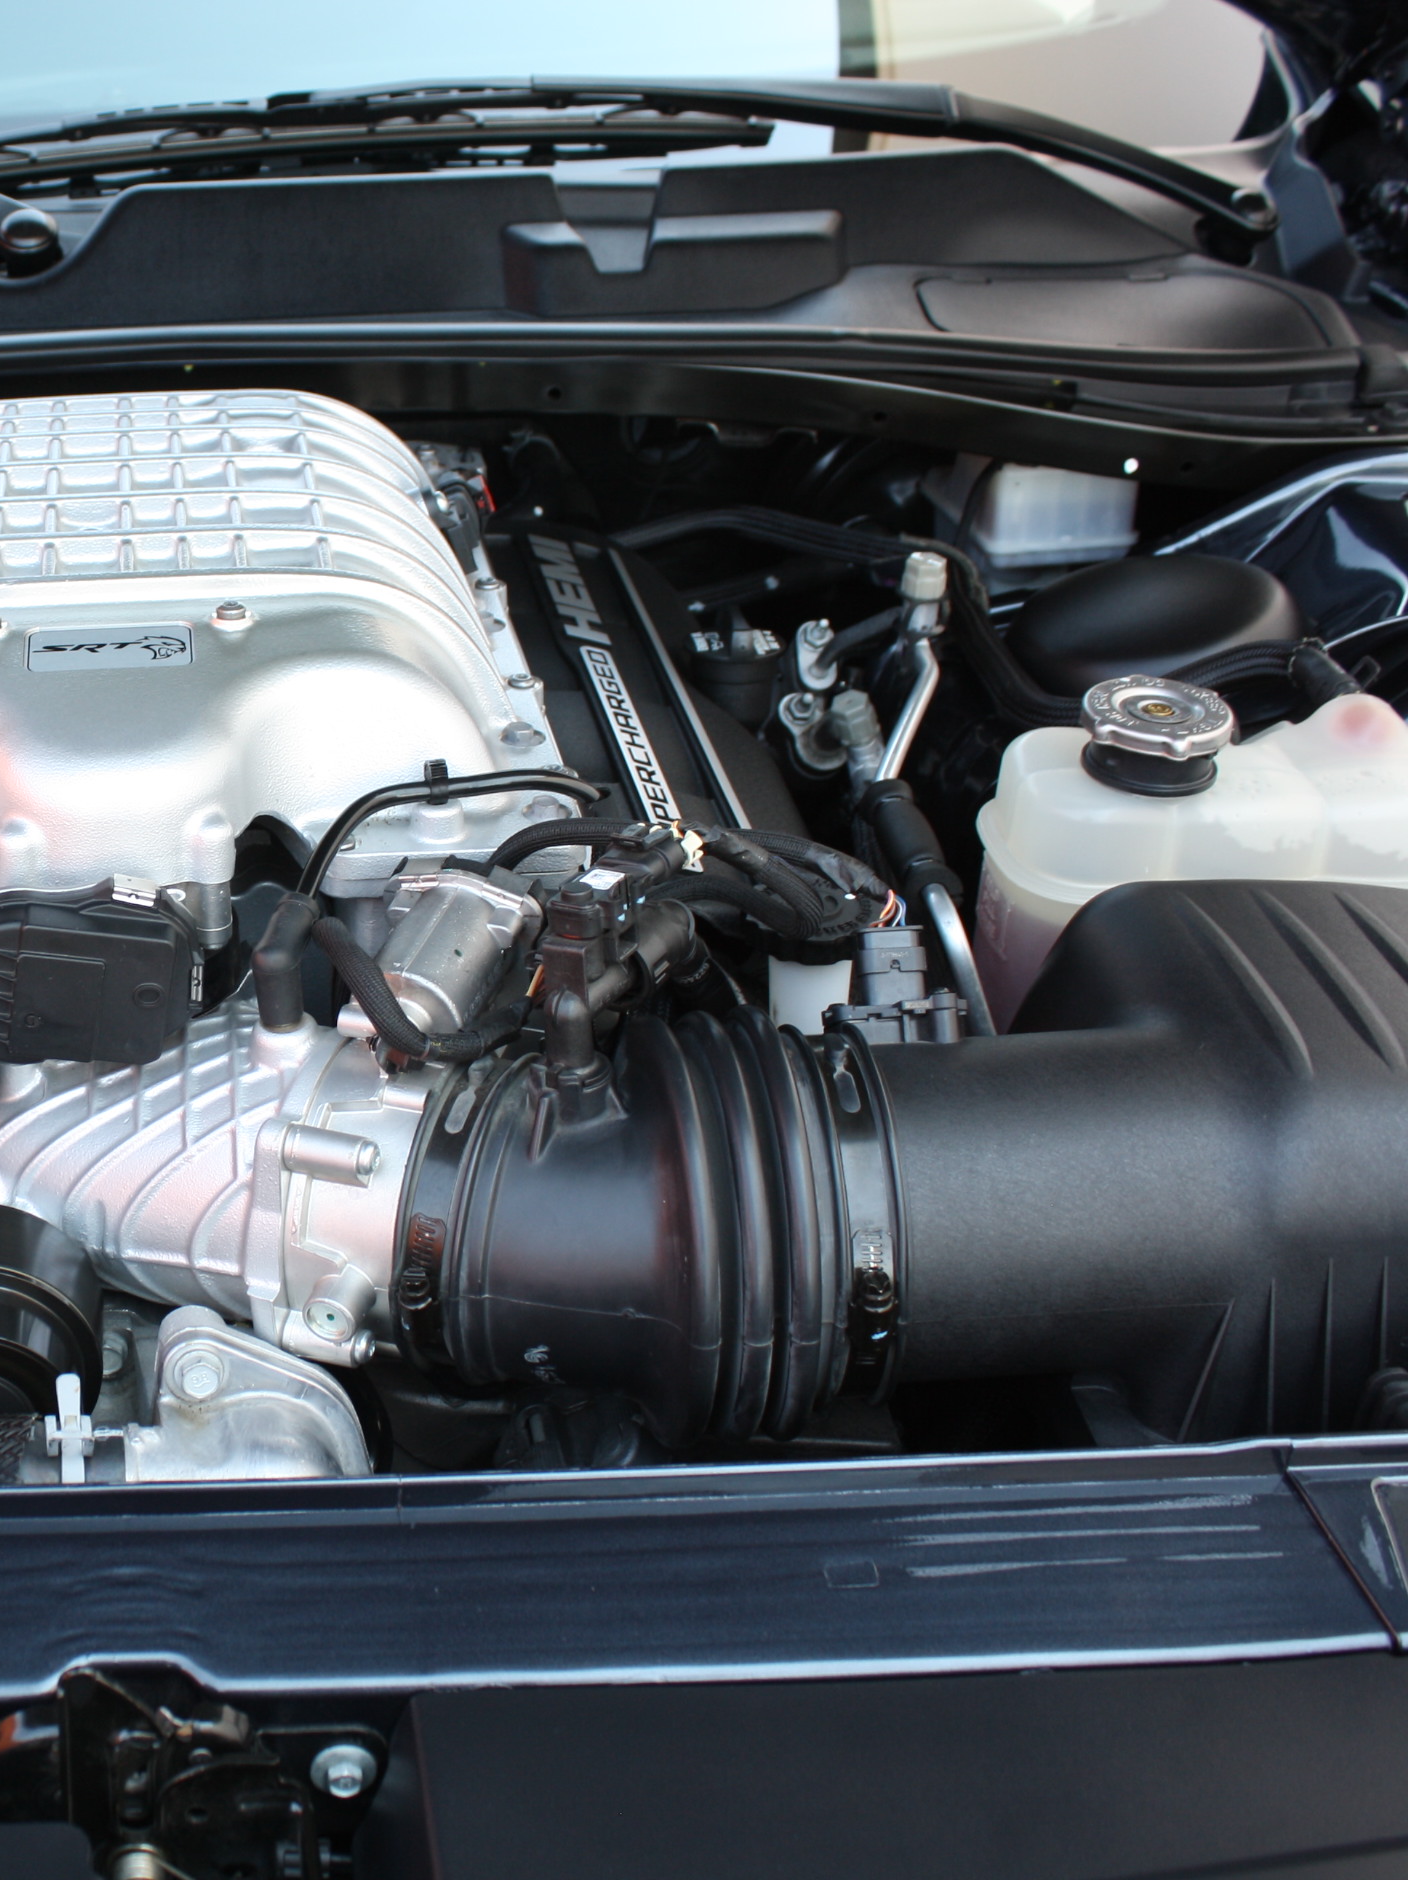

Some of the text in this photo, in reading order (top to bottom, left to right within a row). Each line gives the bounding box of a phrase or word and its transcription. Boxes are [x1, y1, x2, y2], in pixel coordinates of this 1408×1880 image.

[32, 642, 142, 653] SRT
[528, 534, 612, 646] HEMI
[589, 649, 681, 824] PERCHARGED
